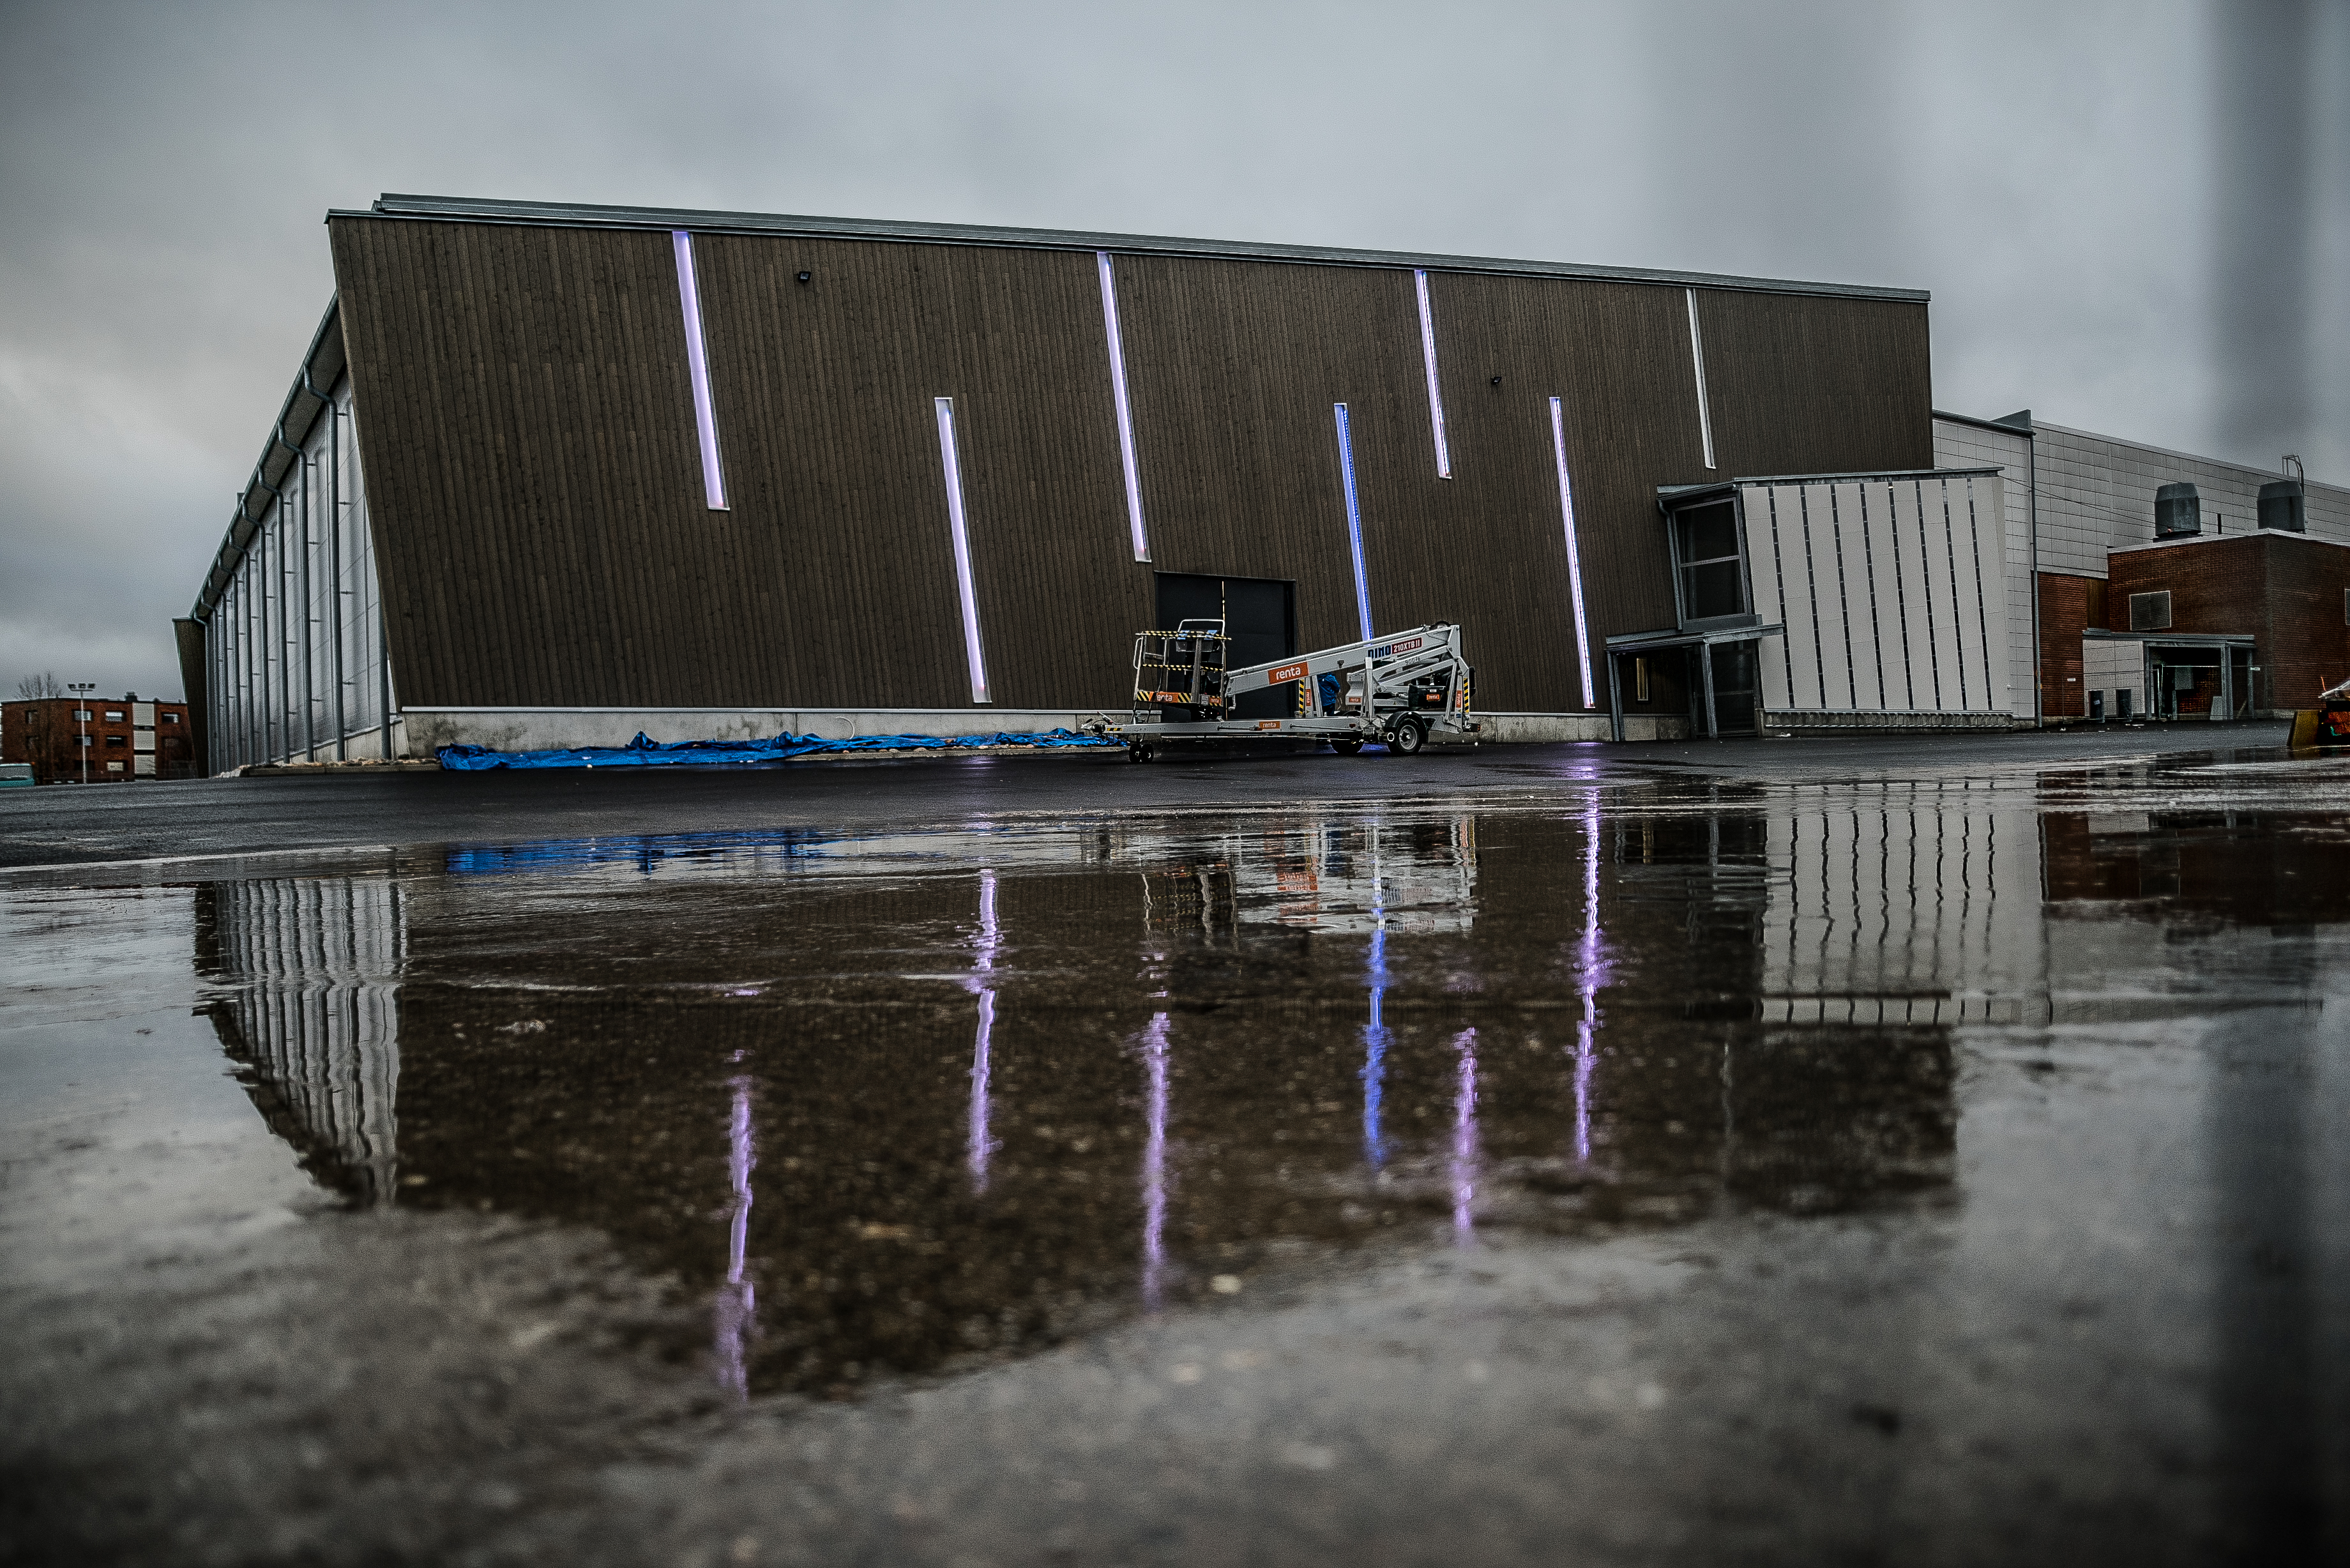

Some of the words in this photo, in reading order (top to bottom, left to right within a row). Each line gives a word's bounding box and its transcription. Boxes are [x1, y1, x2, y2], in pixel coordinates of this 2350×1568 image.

[1368, 645, 1391, 660] DINO
[1393, 640, 1415, 653] 210XTB
[1276, 667, 1301, 681] renta
